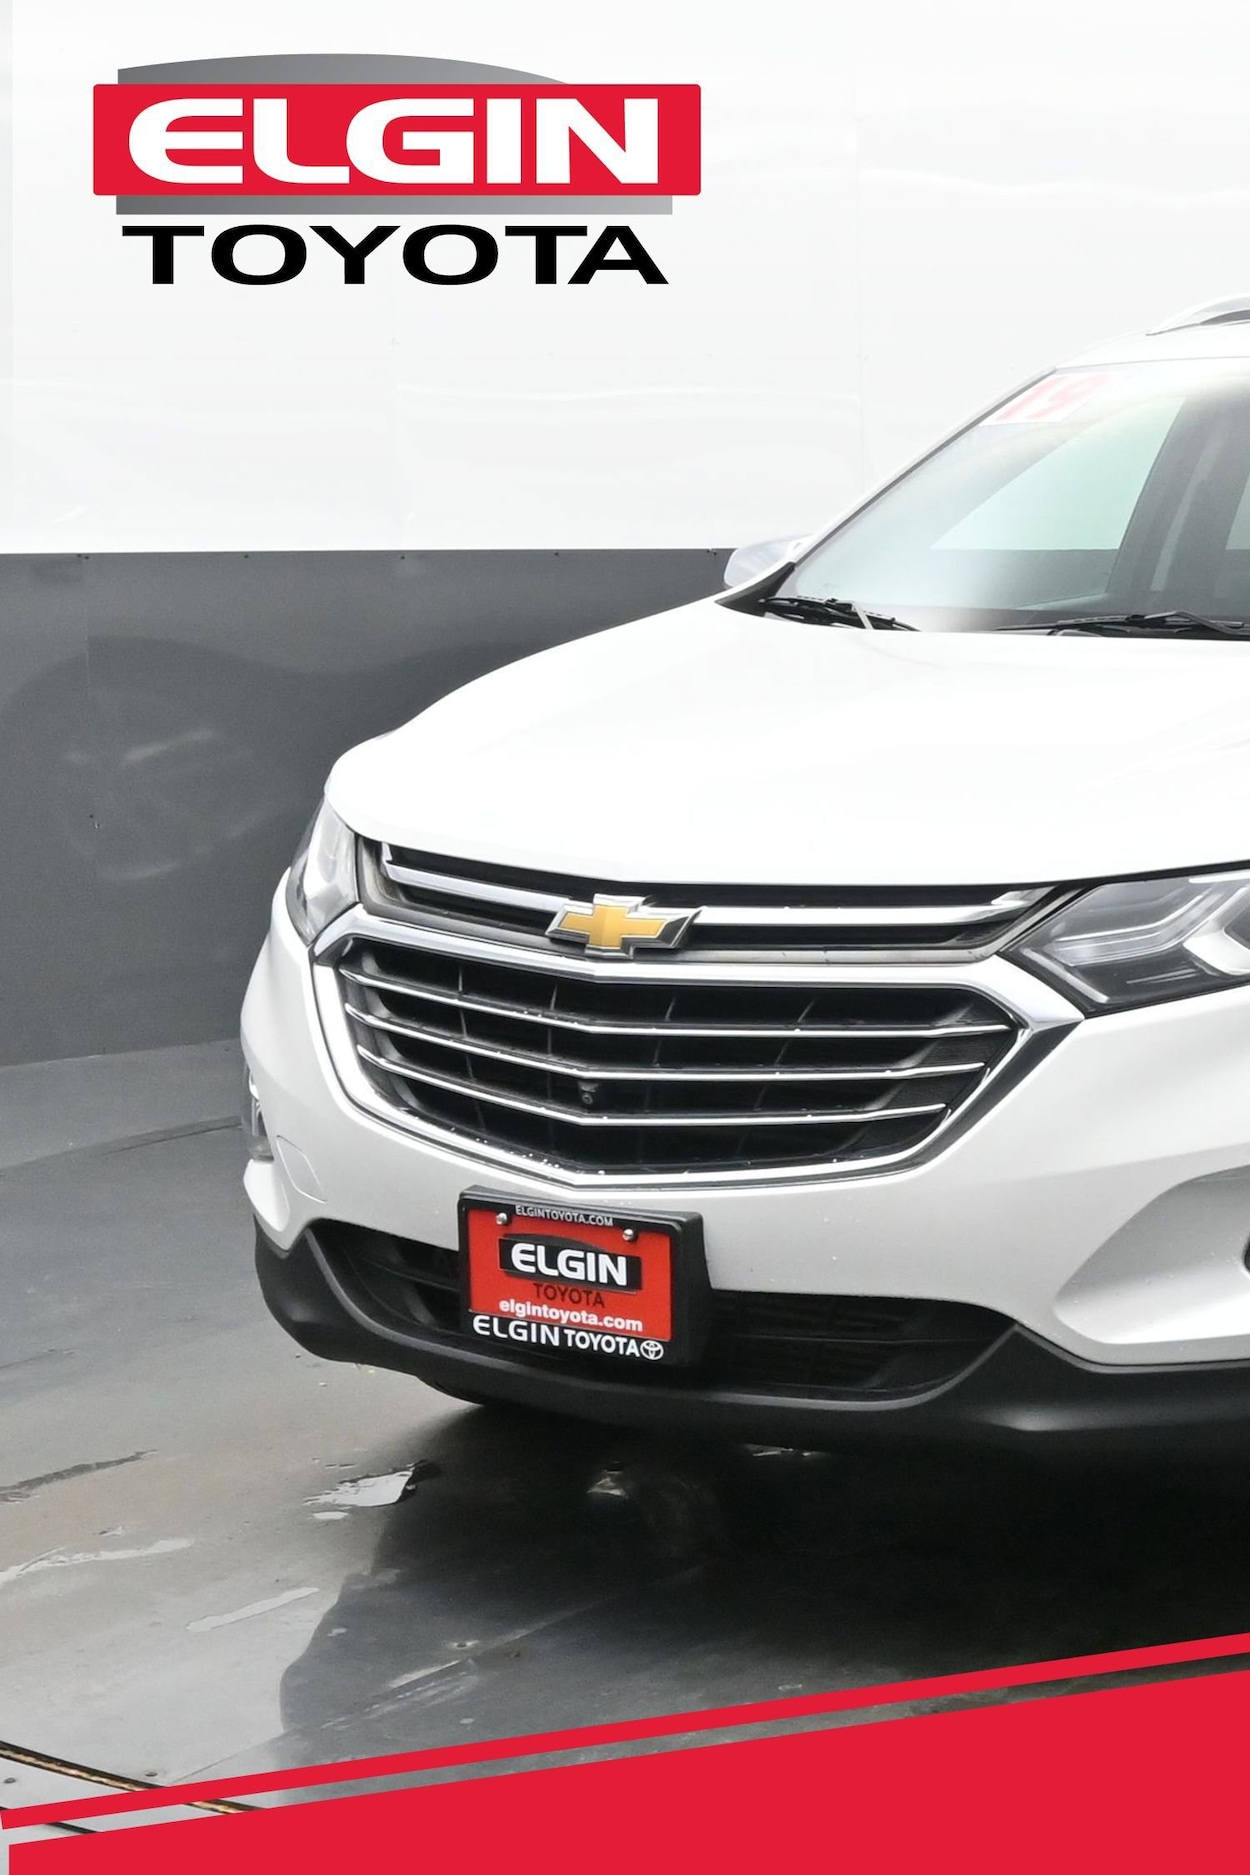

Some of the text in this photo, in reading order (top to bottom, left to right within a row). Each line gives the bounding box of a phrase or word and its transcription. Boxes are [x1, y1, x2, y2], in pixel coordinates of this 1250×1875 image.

[515, 1204, 614, 1228] ELGINTOYOTA.COM
[511, 1242, 628, 1286] ELGIN
[533, 1283, 606, 1309] TOYOTA
[499, 1299, 643, 1332] elgintoyota.com
[472, 1314, 641, 1358] ELGIN TOYOTA
